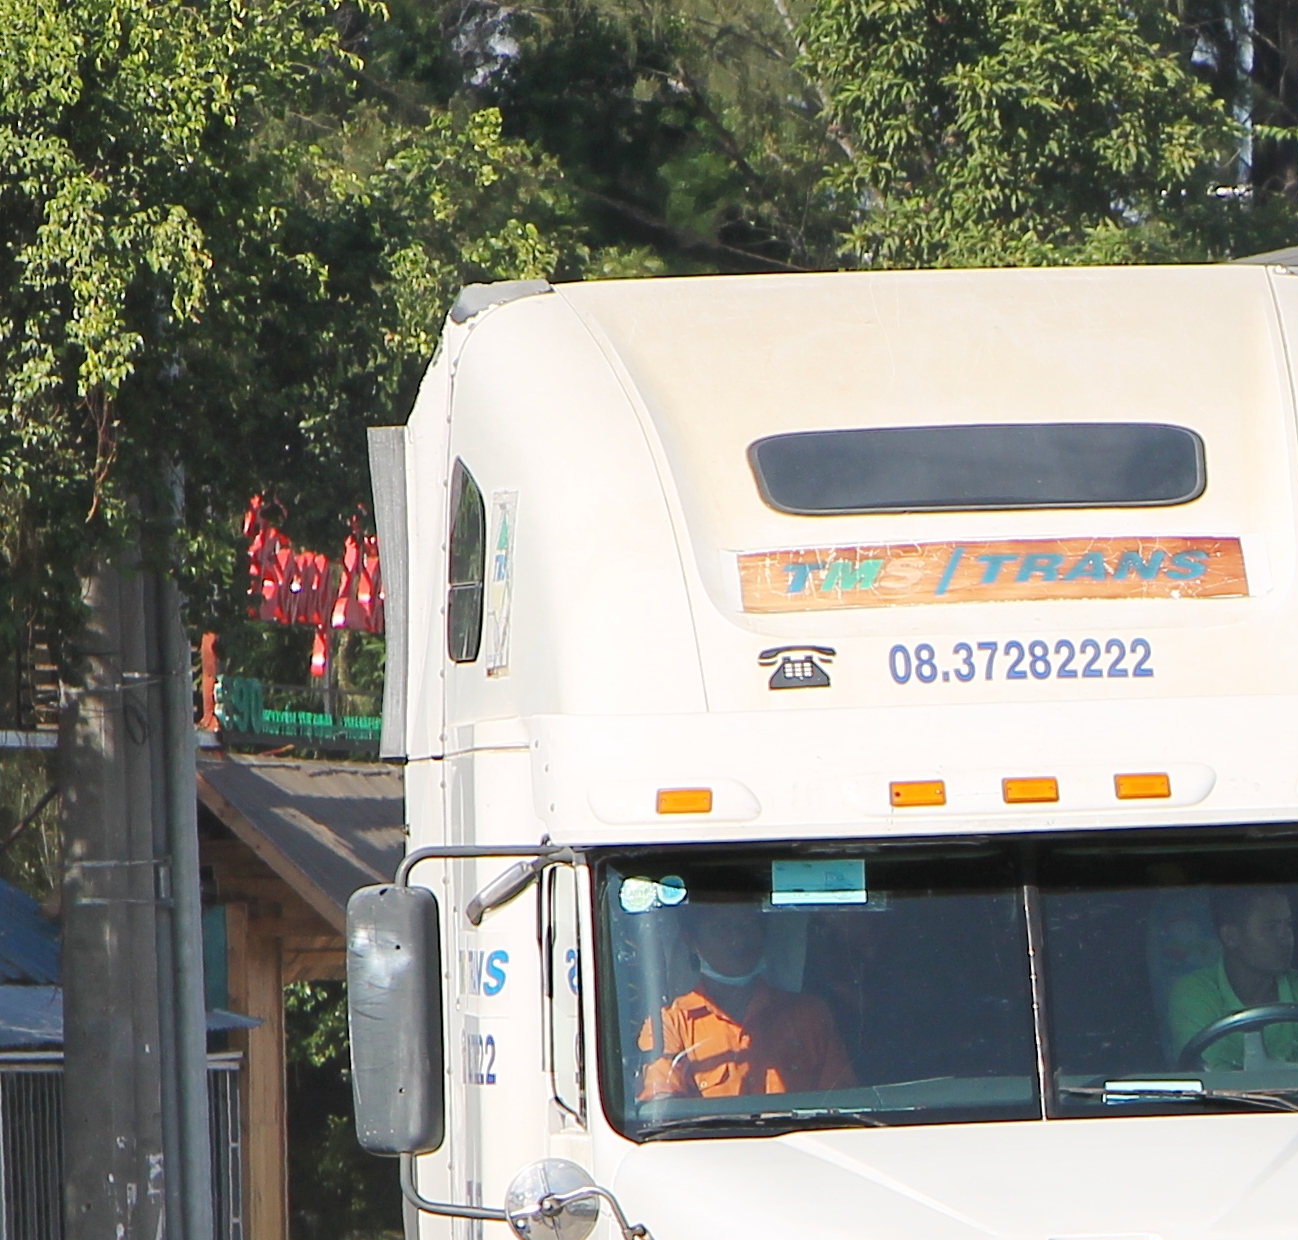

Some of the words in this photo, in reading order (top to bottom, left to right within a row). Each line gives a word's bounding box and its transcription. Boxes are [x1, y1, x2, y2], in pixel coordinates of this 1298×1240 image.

[782, 557, 925, 594] TMS
[976, 549, 1211, 586] TRANS
[888, 637, 1155, 685] 08.37282222
